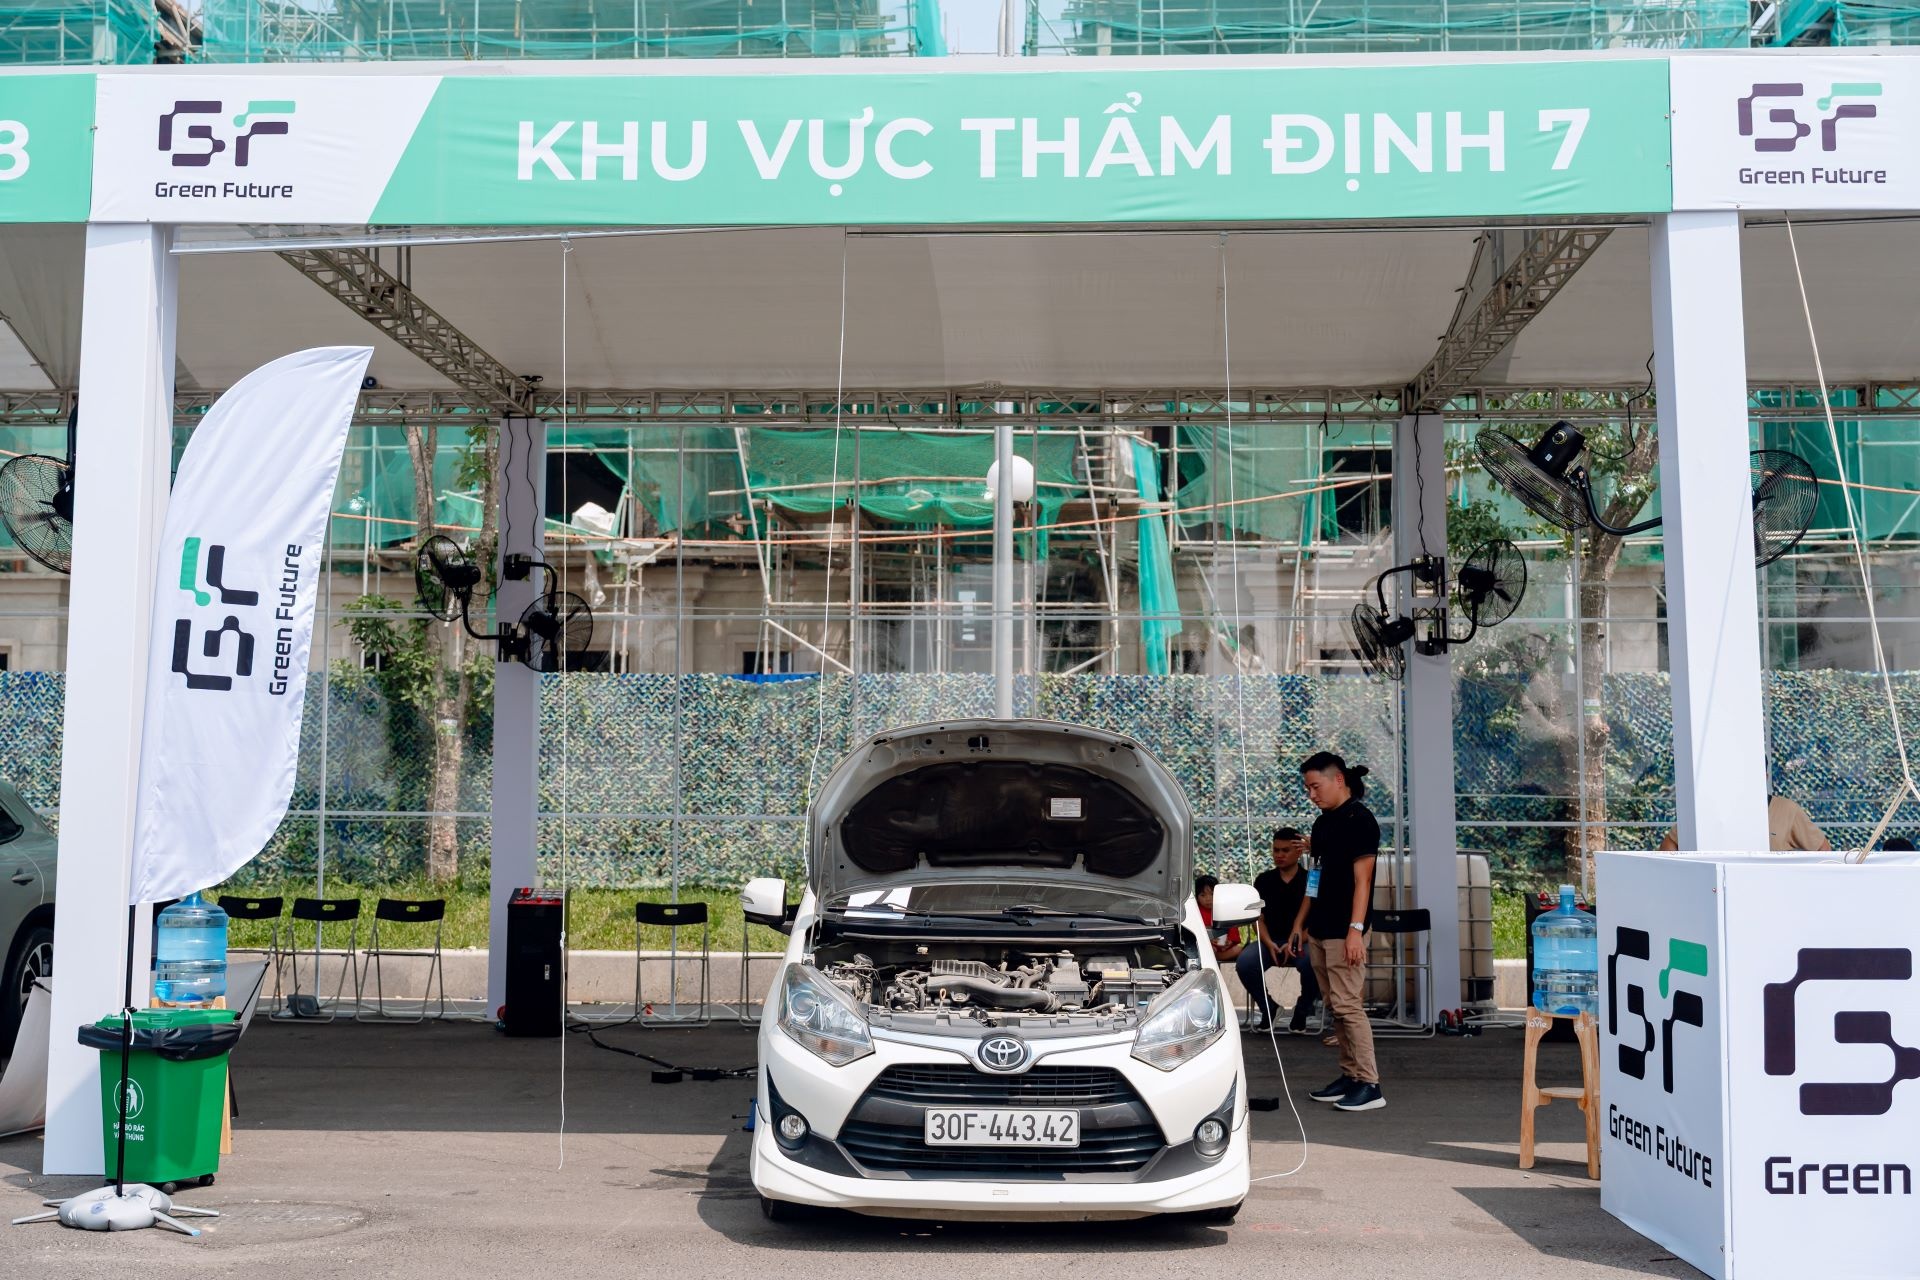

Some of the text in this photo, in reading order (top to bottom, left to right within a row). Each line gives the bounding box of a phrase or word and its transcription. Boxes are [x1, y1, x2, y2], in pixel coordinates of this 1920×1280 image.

[517, 91, 1591, 197] KHU VỰC THẨM ĐỊNH 7
[154, 182, 293, 198] Green Future
[1738, 167, 1887, 185] Green Future
[268, 544, 303, 696] Green Future
[931, 1112, 1074, 1142] 30F-443.42
[1609, 1103, 1712, 1189] Green Future
[1764, 1156, 1912, 1195] Green
